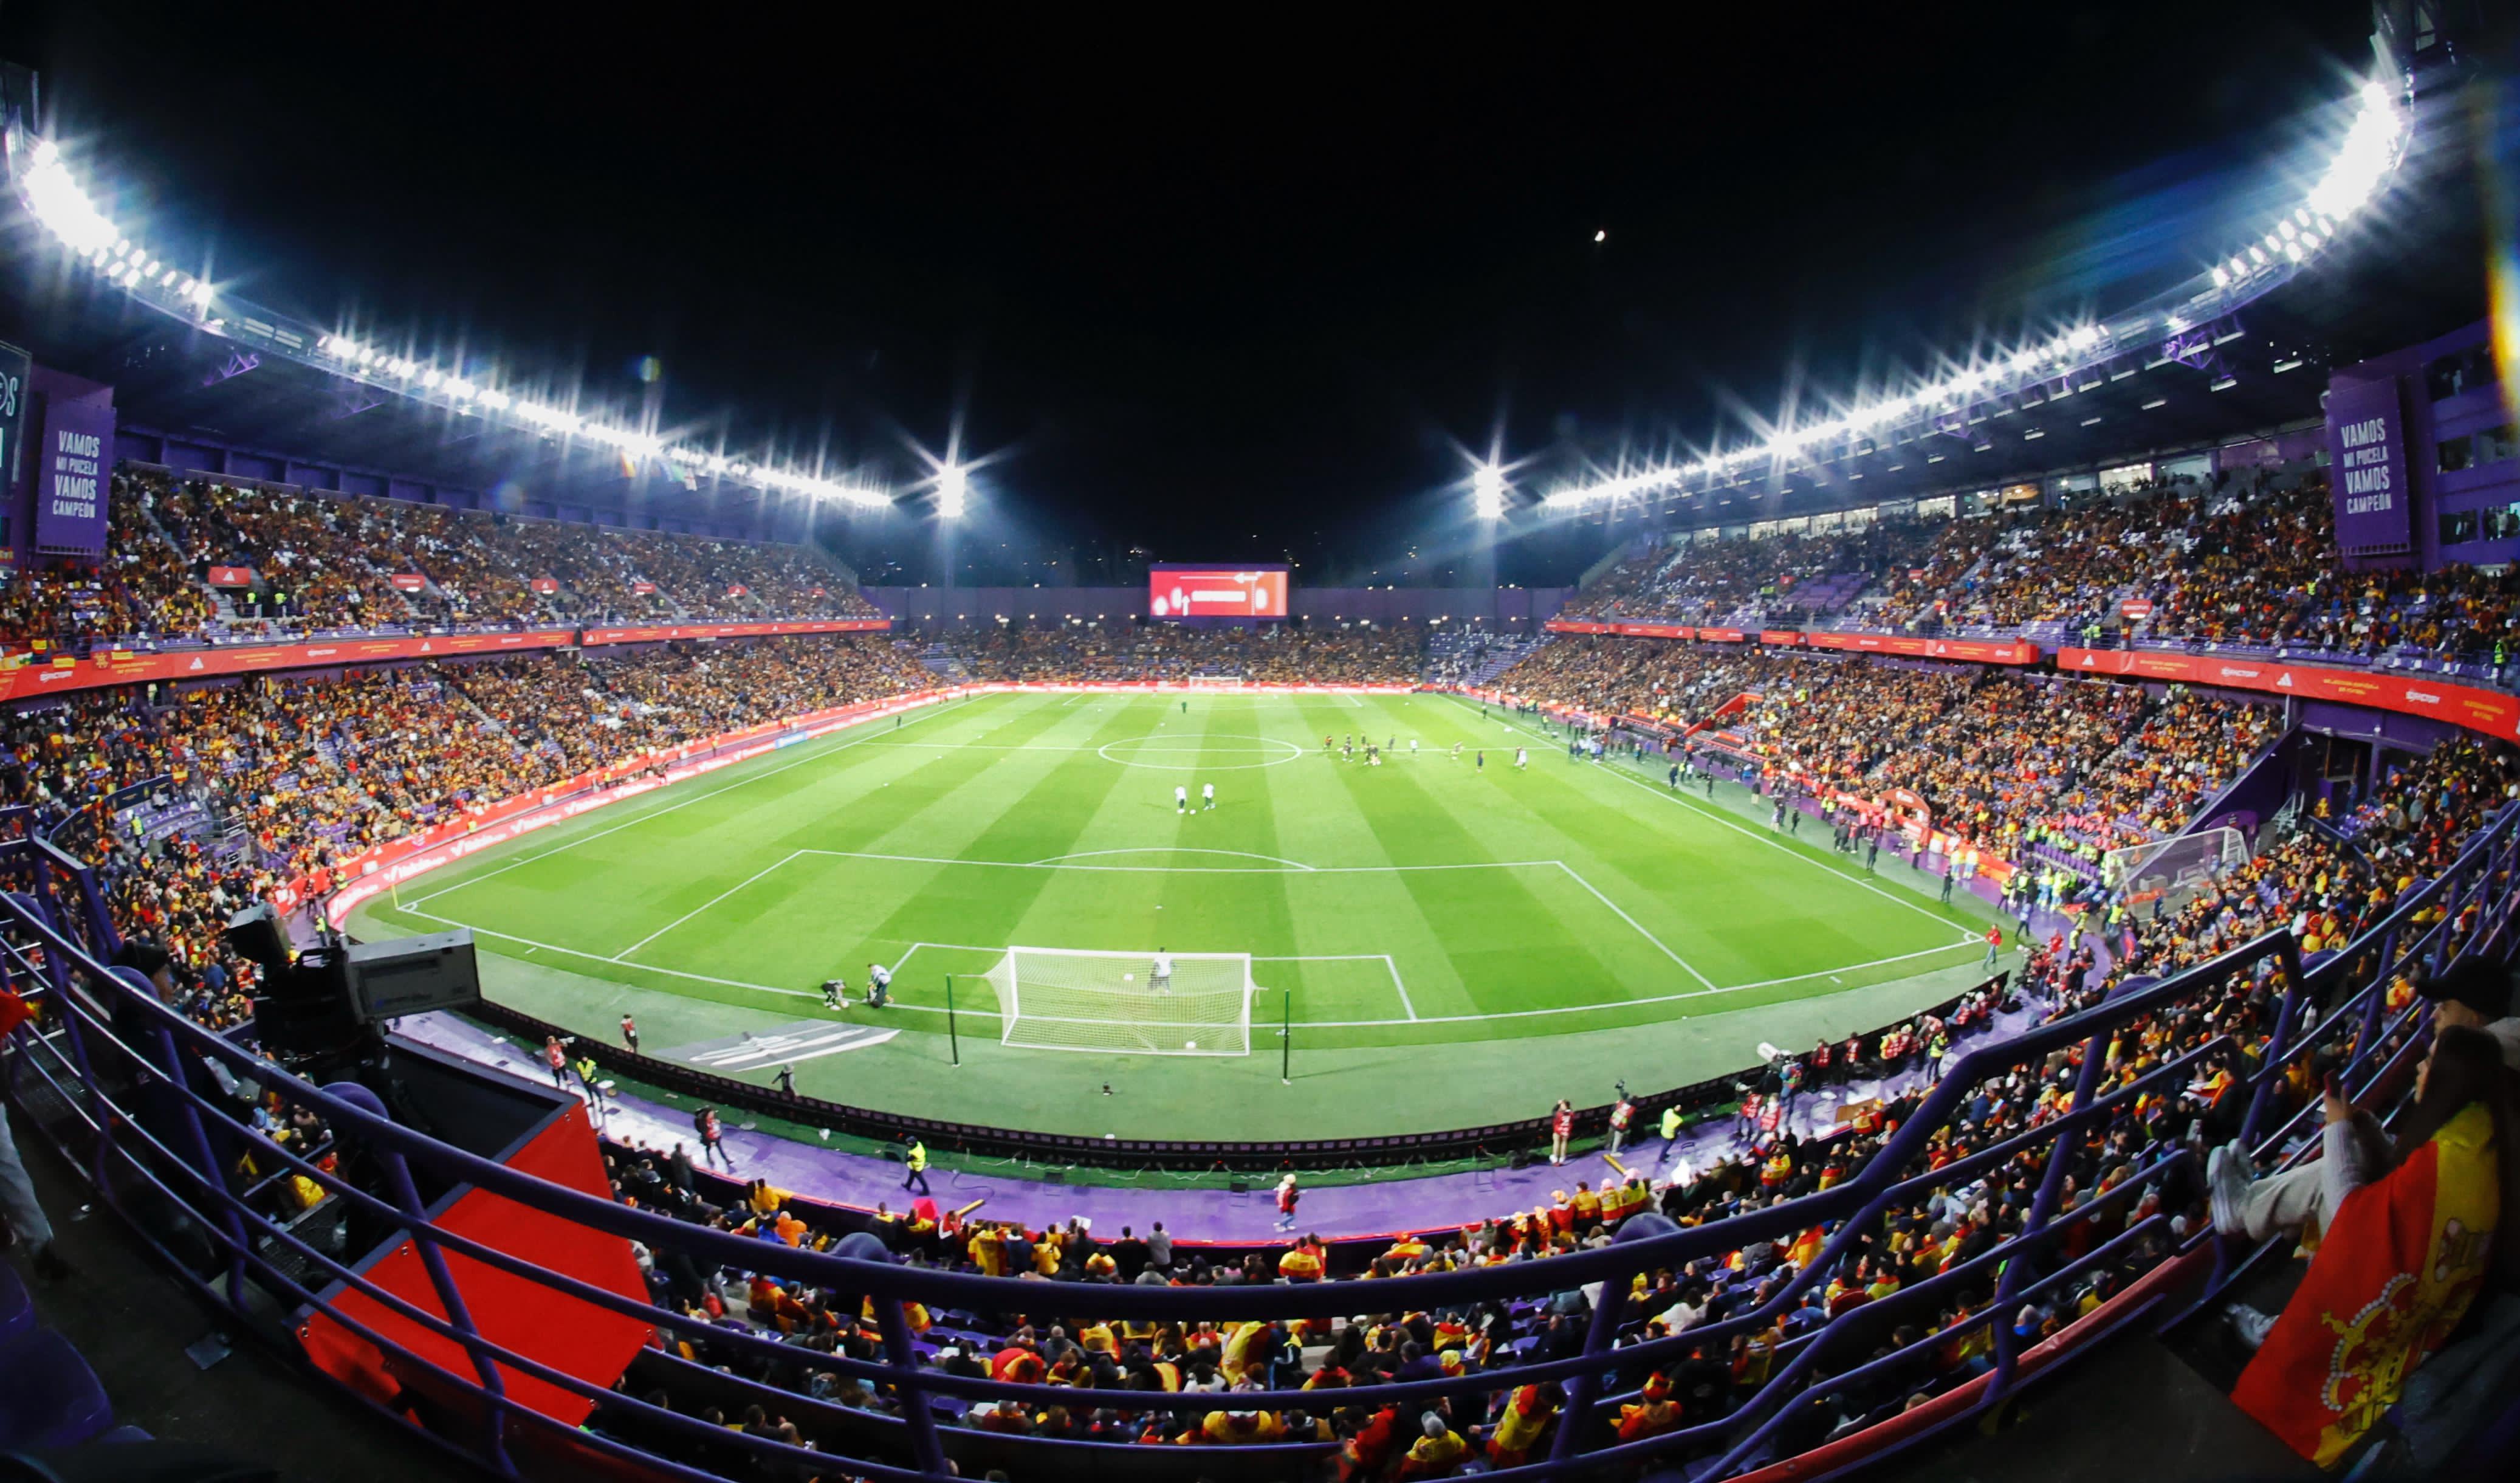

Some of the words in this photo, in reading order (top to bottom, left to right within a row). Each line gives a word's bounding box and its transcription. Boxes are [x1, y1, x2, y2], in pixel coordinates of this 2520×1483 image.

[59, 430, 100, 458] VAMOS
[2341, 418, 2386, 449] VAMOS
[69, 458, 98, 476] PUCELA
[2343, 452, 2355, 468] MI
[2356, 446, 2389, 466] PUCELA
[55, 475, 97, 500] VAMOS
[2345, 466, 2391, 495] VAMOS
